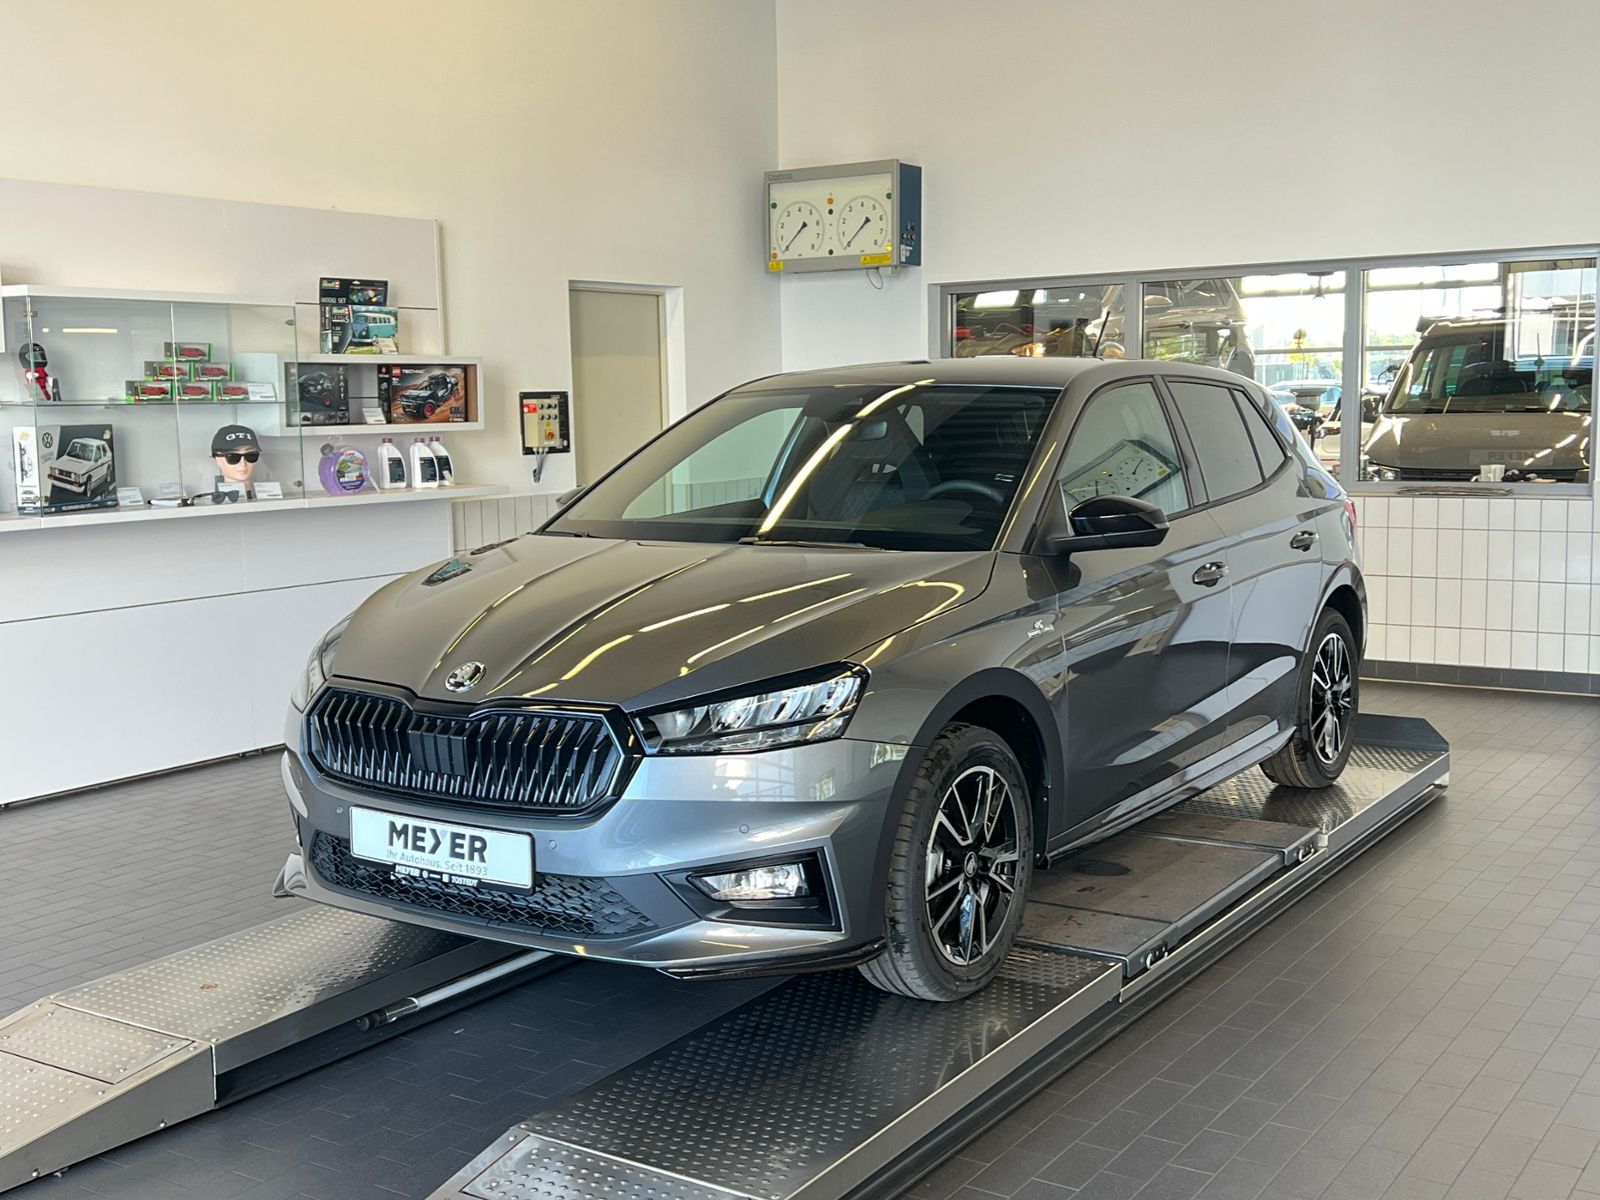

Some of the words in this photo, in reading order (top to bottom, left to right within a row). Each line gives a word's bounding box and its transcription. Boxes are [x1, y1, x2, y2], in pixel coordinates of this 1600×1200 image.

[225, 432, 252, 441] GTI
[388, 821, 487, 863] MEYER
[386, 848, 398, 859] Ihr
[399, 852, 443, 868] Autohaus.
[444, 861, 463, 873] Seit
[465, 864, 488, 876] 1893
